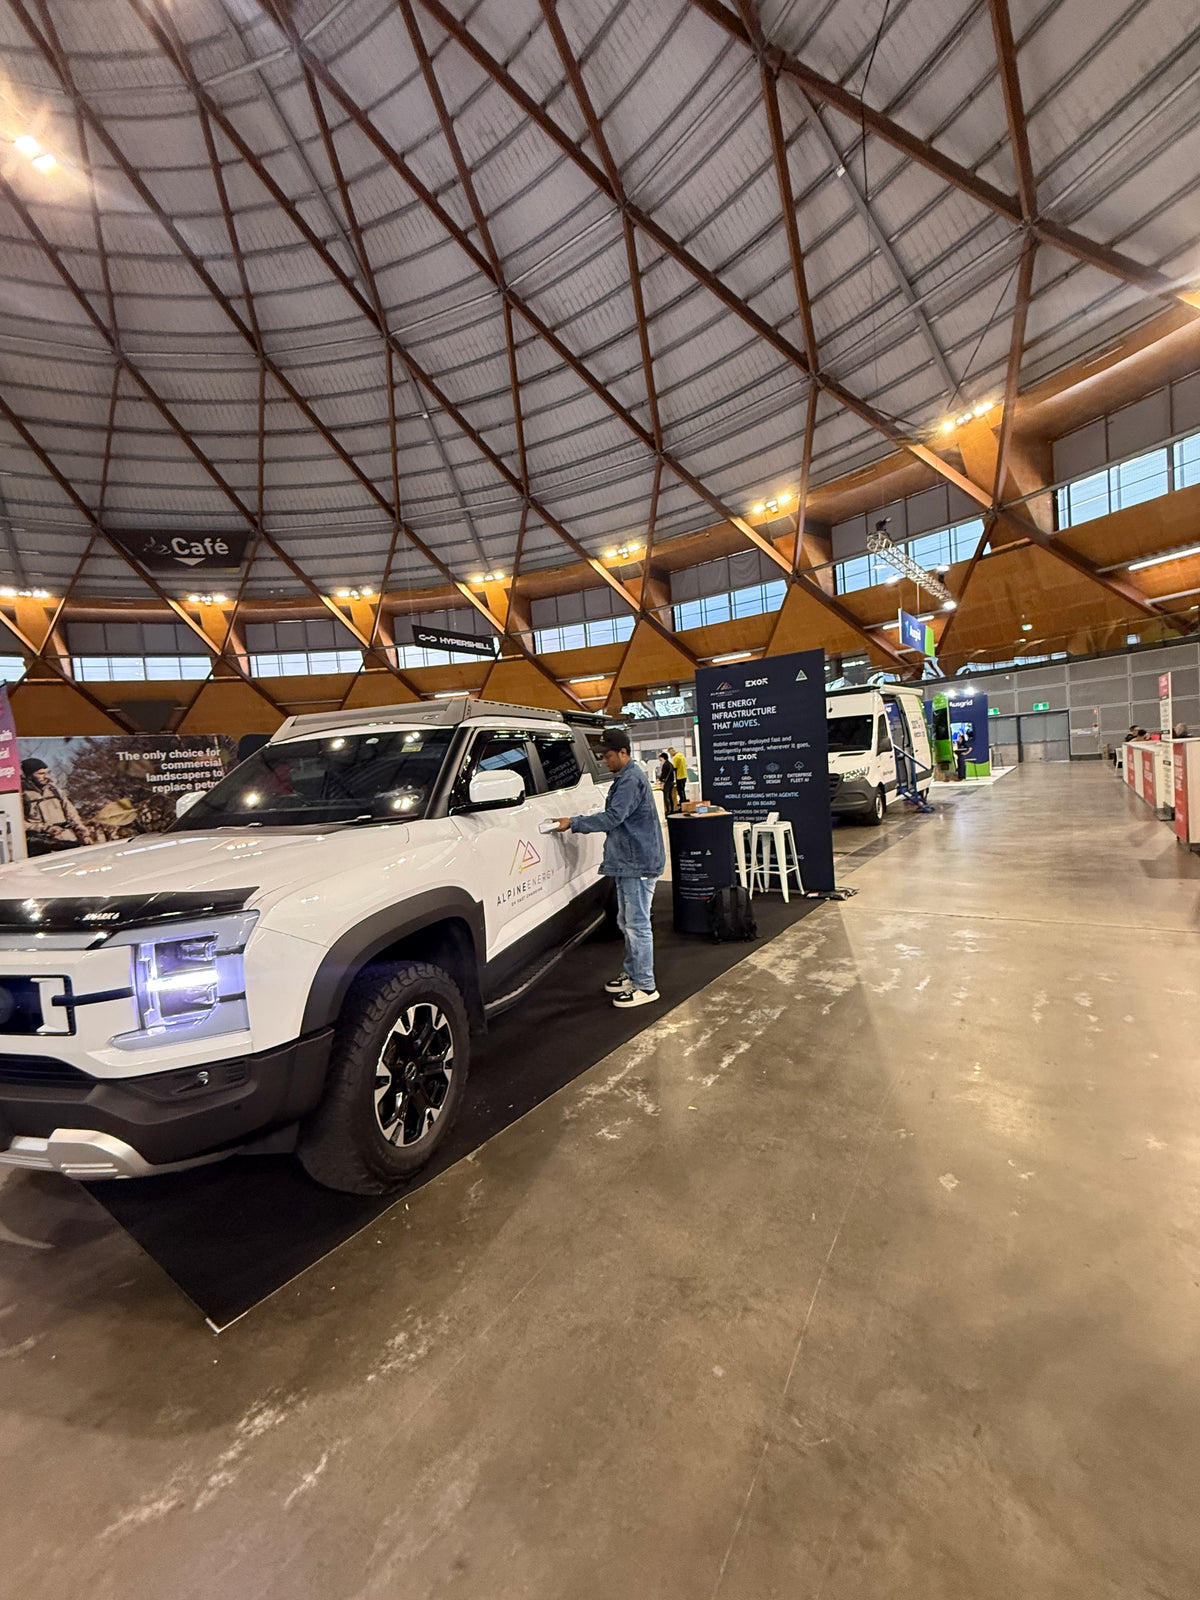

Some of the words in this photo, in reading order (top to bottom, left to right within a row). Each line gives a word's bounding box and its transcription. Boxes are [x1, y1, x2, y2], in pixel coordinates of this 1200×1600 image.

[170, 537, 229, 555] Café
[439, 637, 492, 650] HYPERSHELL
[711, 702, 726, 710] THE
[727, 698, 757, 708] ENERGY
[711, 706, 777, 720] INFRASTRUCTURE
[712, 721, 731, 730] THAT
[732, 719, 760, 728] MOVES.
[116, 751, 140, 760] The
[142, 750, 167, 760] only
[169, 749, 205, 758] choice
[206, 748, 221, 756] for
[161, 758, 222, 769] commercial
[146, 771, 211, 782] landscapers
[212, 769, 223, 777] to
[152, 782, 193, 793] replace
